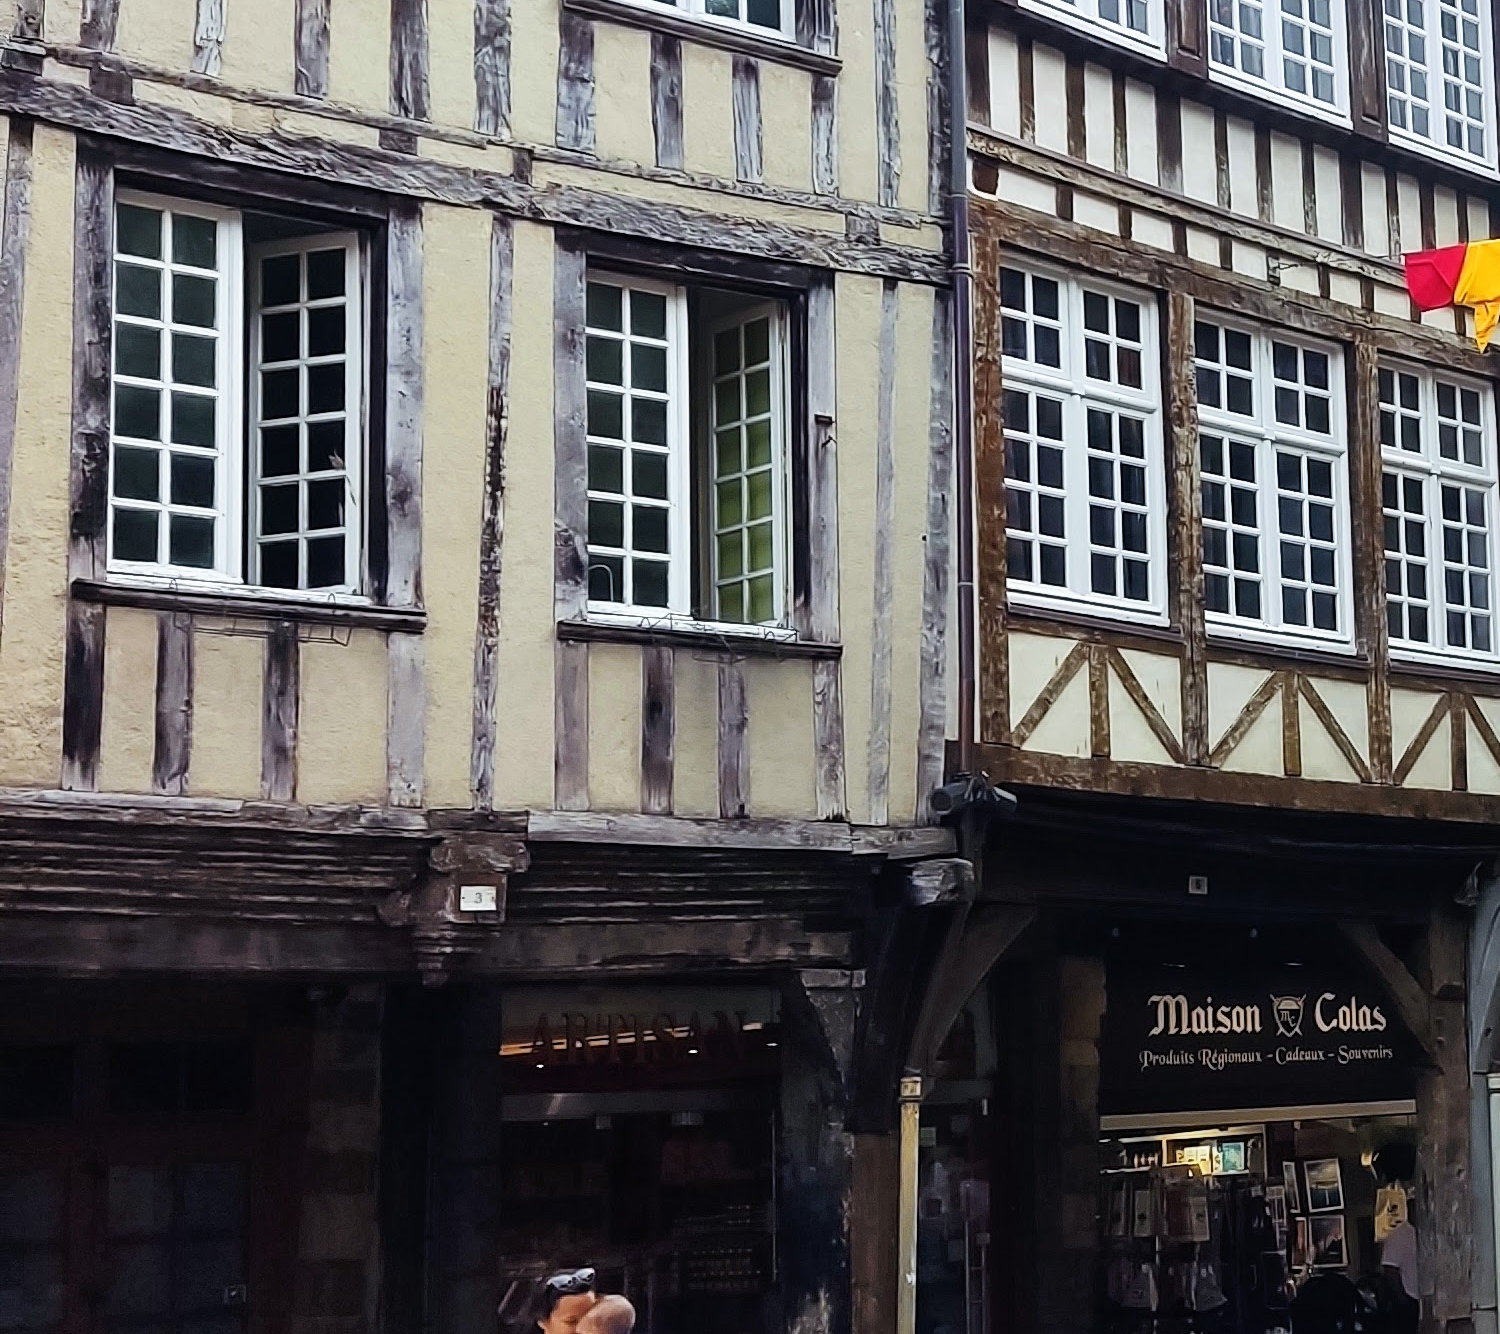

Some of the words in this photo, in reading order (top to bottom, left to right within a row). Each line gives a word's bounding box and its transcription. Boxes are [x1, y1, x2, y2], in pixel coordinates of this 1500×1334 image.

[473, 892, 483, 904] 3
[1147, 994, 1264, 1038] Maison
[1314, 992, 1388, 1033] Colas
[1139, 1049, 1195, 1072] Produits
[1198, 1047, 1263, 1071] Régionaux
[1275, 1046, 1326, 1066] Cadeaux
[1337, 1044, 1394, 1065] Souvenirs
